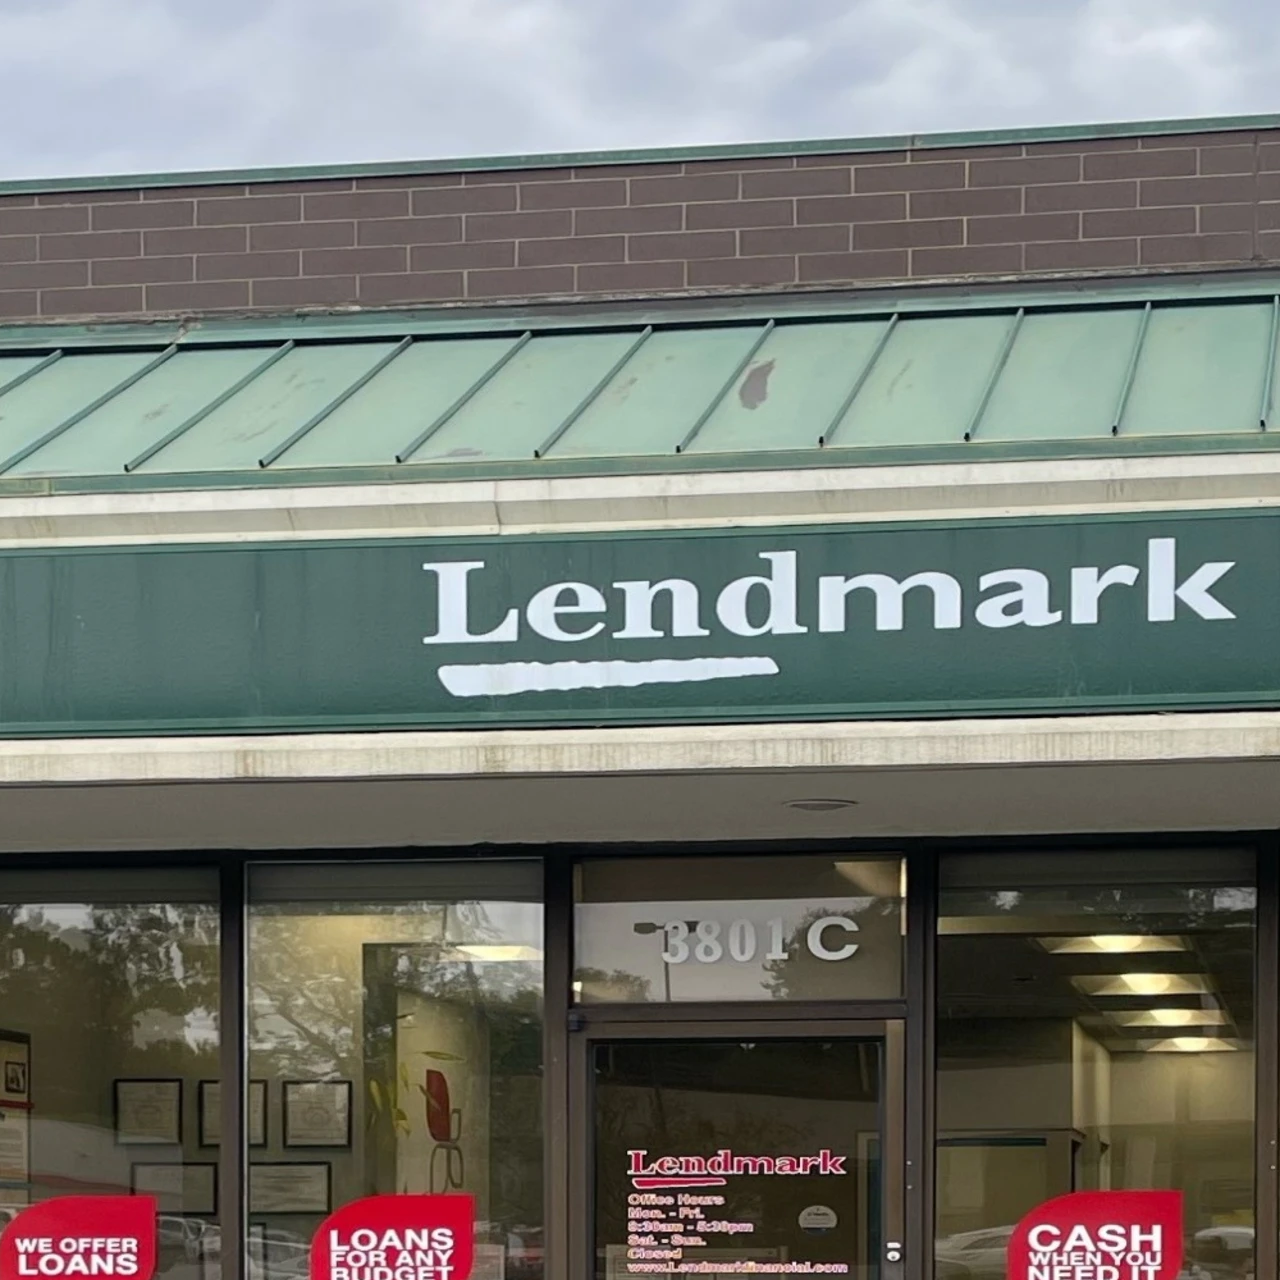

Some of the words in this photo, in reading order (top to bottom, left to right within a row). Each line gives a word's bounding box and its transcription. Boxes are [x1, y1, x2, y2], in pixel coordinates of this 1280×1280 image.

[422, 537, 1237, 645] Lendmark
[661, 917, 789, 964] 3801
[807, 915, 860, 961] C
[626, 1149, 847, 1175] Lendmark
[628, 1194, 675, 1205] Office
[677, 1193, 726, 1205] Hours
[628, 1207, 666, 1219] Mon.
[679, 1207, 705, 1219] Fri.
[15, 1238, 53, 1253] WE
[59, 1237, 138, 1253] OFFER
[330, 1228, 454, 1252] LOANS
[627, 1234, 658, 1246] Sat.
[671, 1234, 707, 1246] Sun.
[1028, 1224, 1162, 1252] CASH
[330, 1250, 387, 1267] FOR
[395, 1249, 454, 1267] ANY
[627, 1248, 682, 1259] Closed
[1028, 1251, 1102, 1266] WHEN
[1109, 1251, 1162, 1266] YOU
[18, 1253, 138, 1275] LOANS
